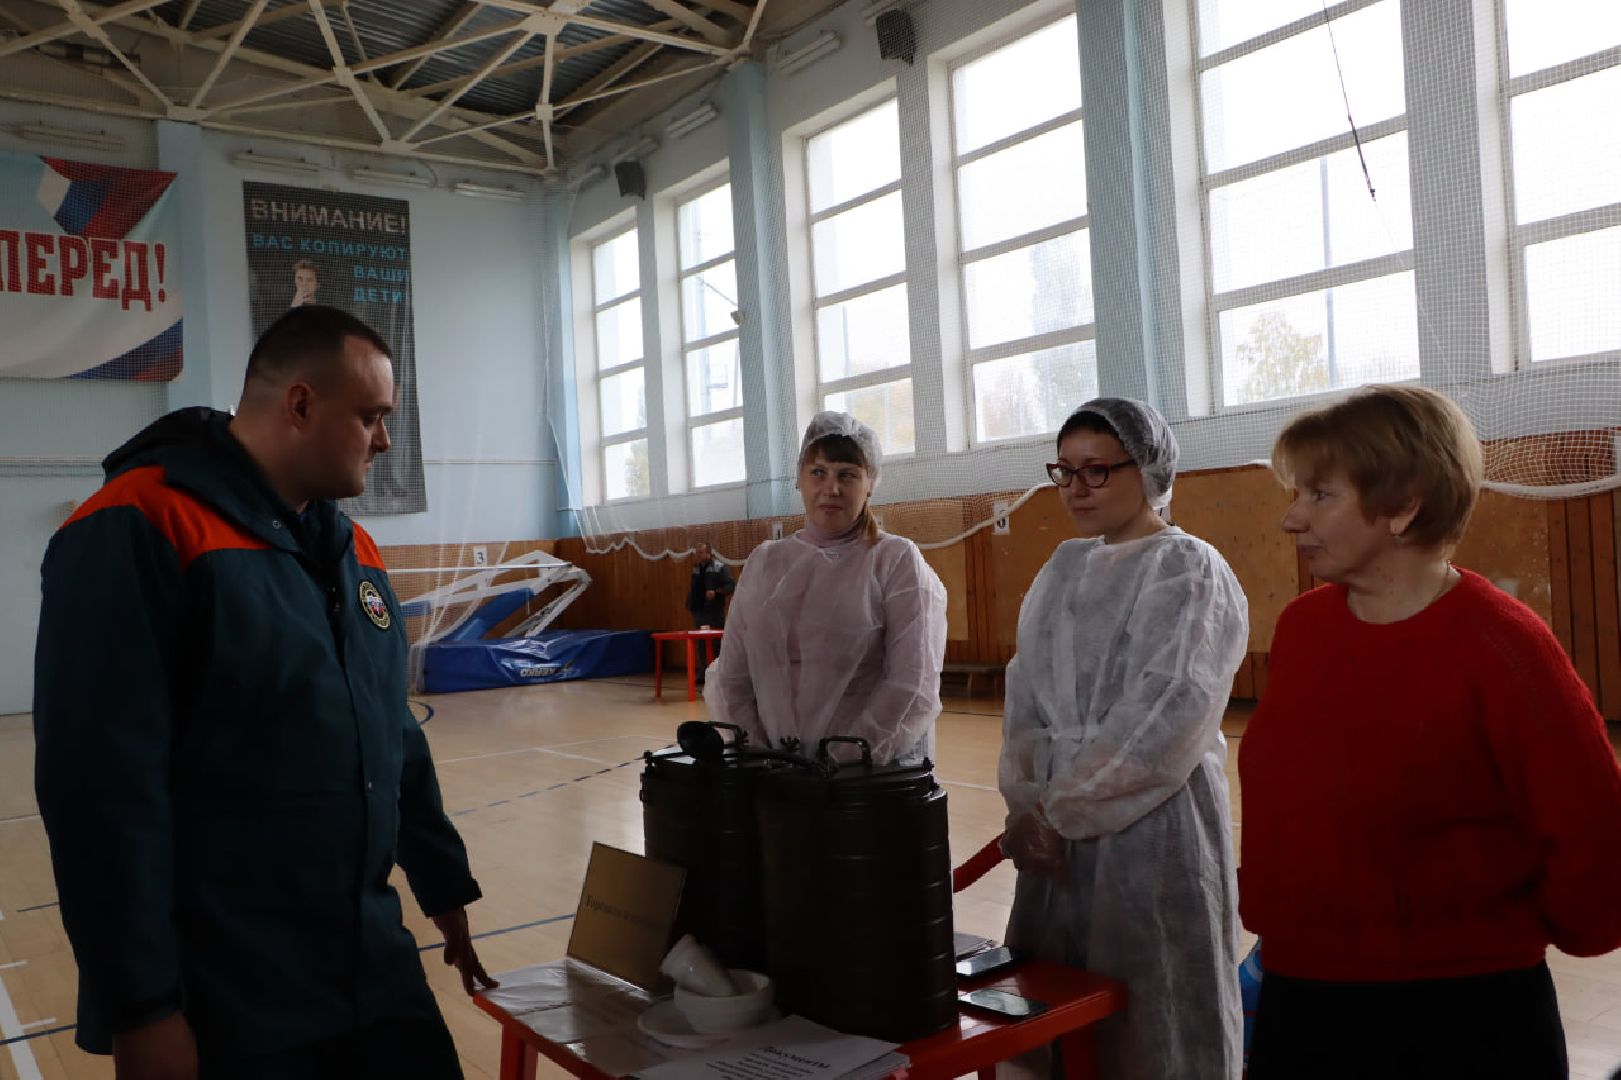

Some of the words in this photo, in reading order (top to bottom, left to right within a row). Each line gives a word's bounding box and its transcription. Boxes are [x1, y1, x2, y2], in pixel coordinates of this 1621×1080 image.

[251, 200, 406, 234] ВНИМАНИЕ!
[252, 233, 293, 250] ВАС
[300, 239, 405, 260] КОПИРУЮТ
[477, 551, 484, 565] 3
